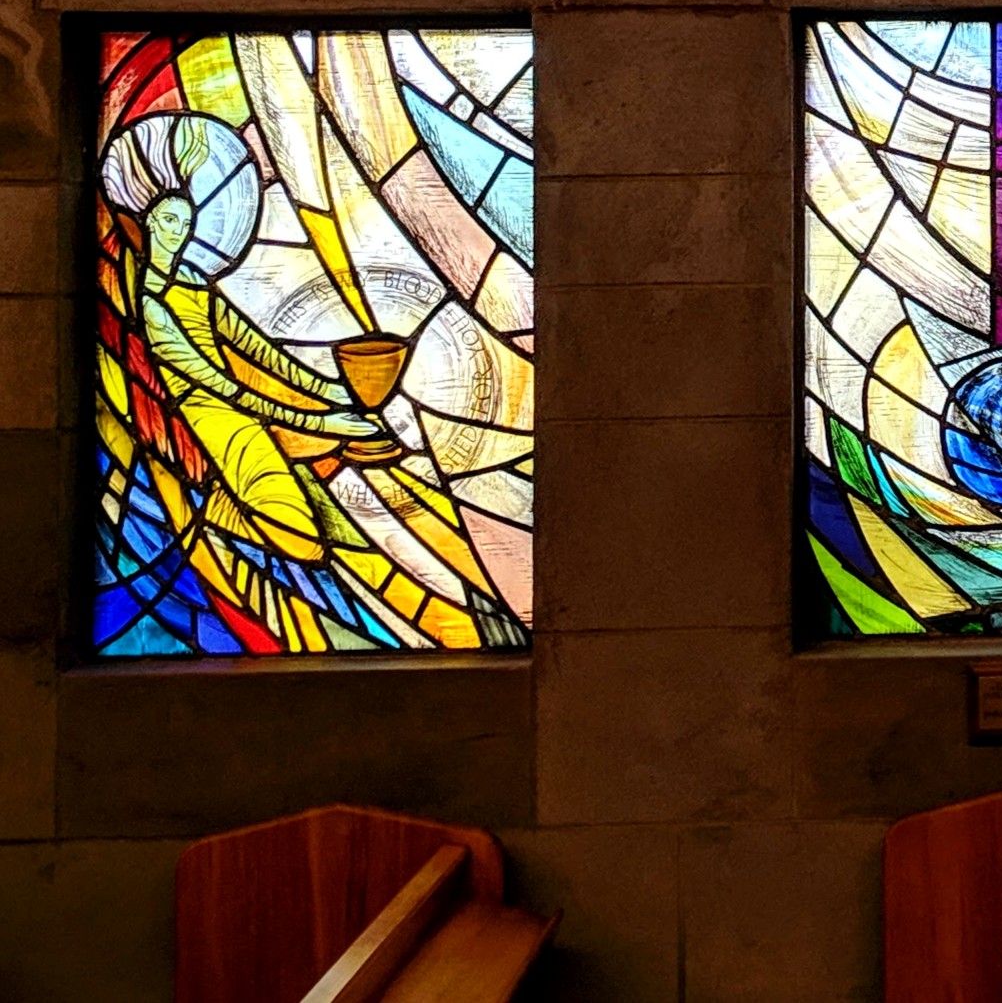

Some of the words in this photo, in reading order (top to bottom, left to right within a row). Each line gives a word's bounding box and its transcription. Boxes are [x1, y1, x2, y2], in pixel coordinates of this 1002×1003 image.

[271, 299, 308, 335] THIS
[383, 270, 442, 305] BLOOD
[450, 315, 485, 361] YOU
[470, 362, 493, 415] FOR
[439, 425, 478, 475] SHED
